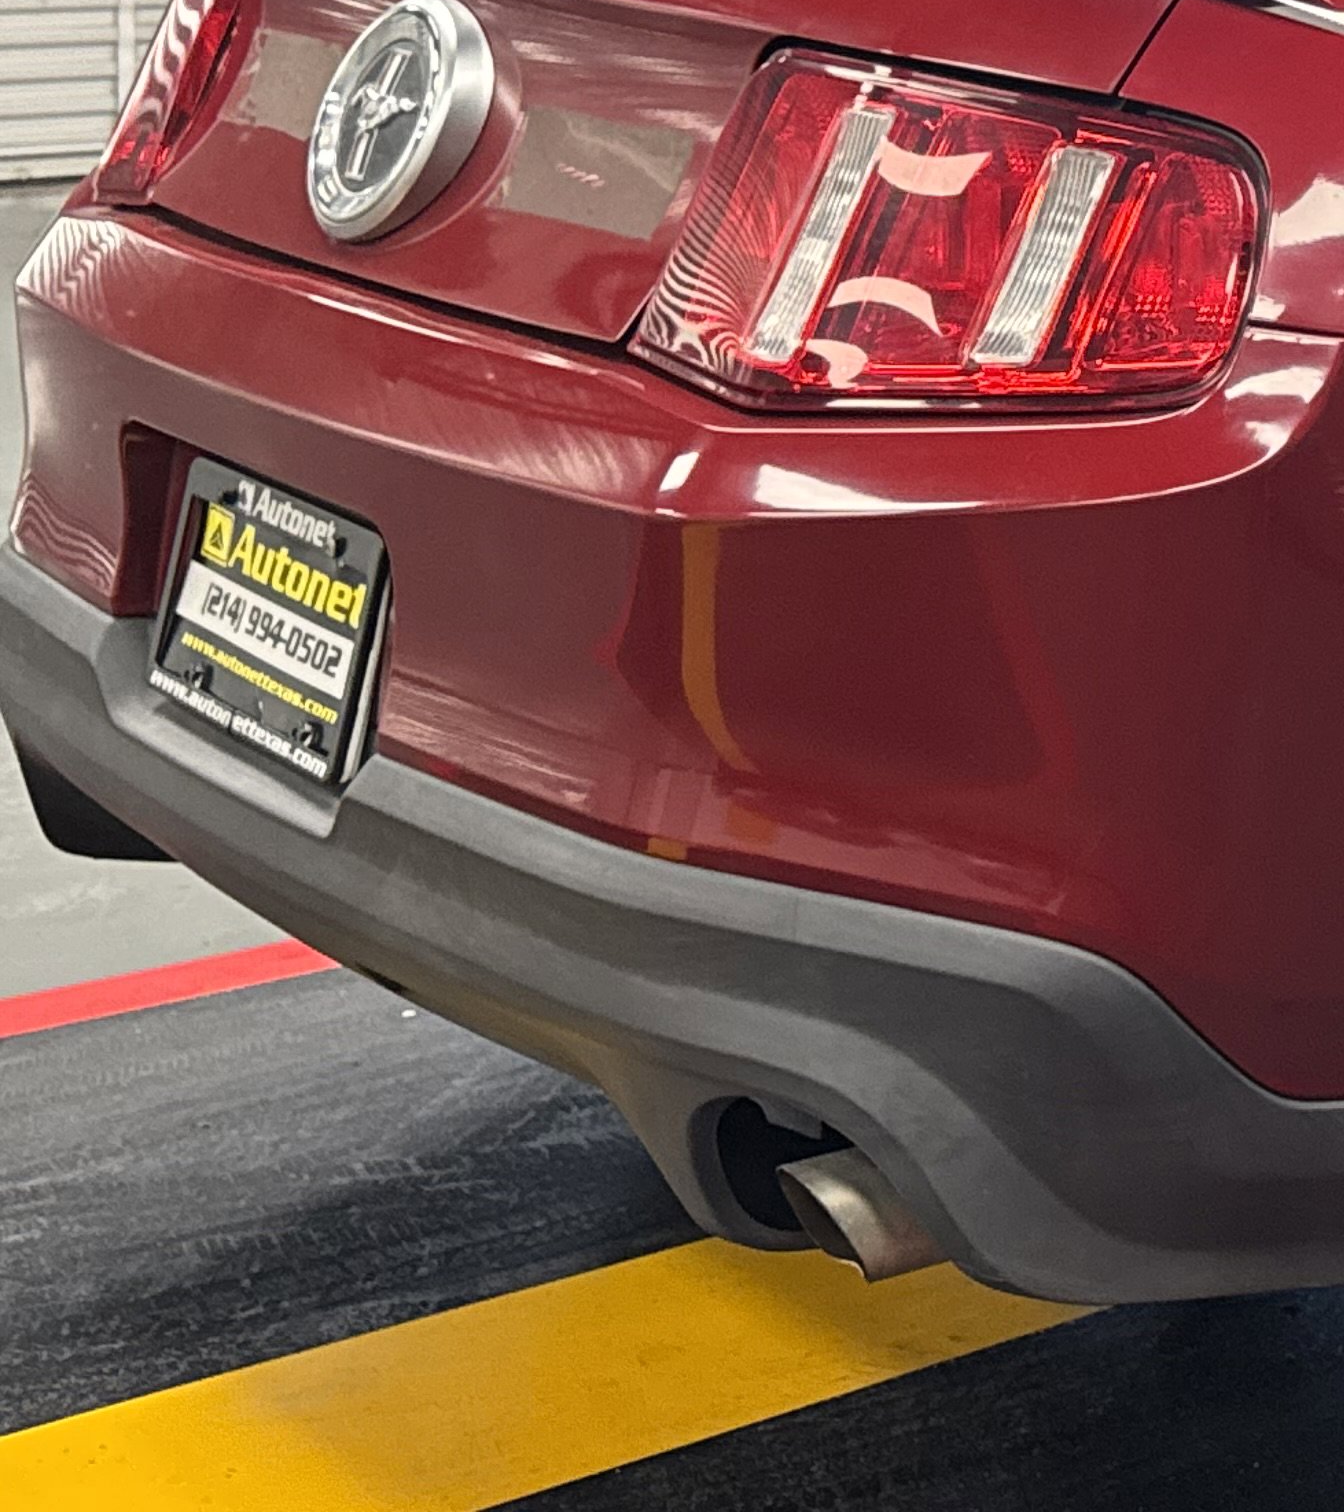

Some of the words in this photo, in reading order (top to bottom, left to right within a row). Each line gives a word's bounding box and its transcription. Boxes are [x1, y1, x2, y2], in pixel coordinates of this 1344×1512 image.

[253, 489, 341, 555] Autonet
[228, 524, 367, 629] Autonet
[201, 582, 247, 633] (214)
[245, 605, 343, 678] 994-0502
[181, 632, 339, 725] www.autonettexas.com
